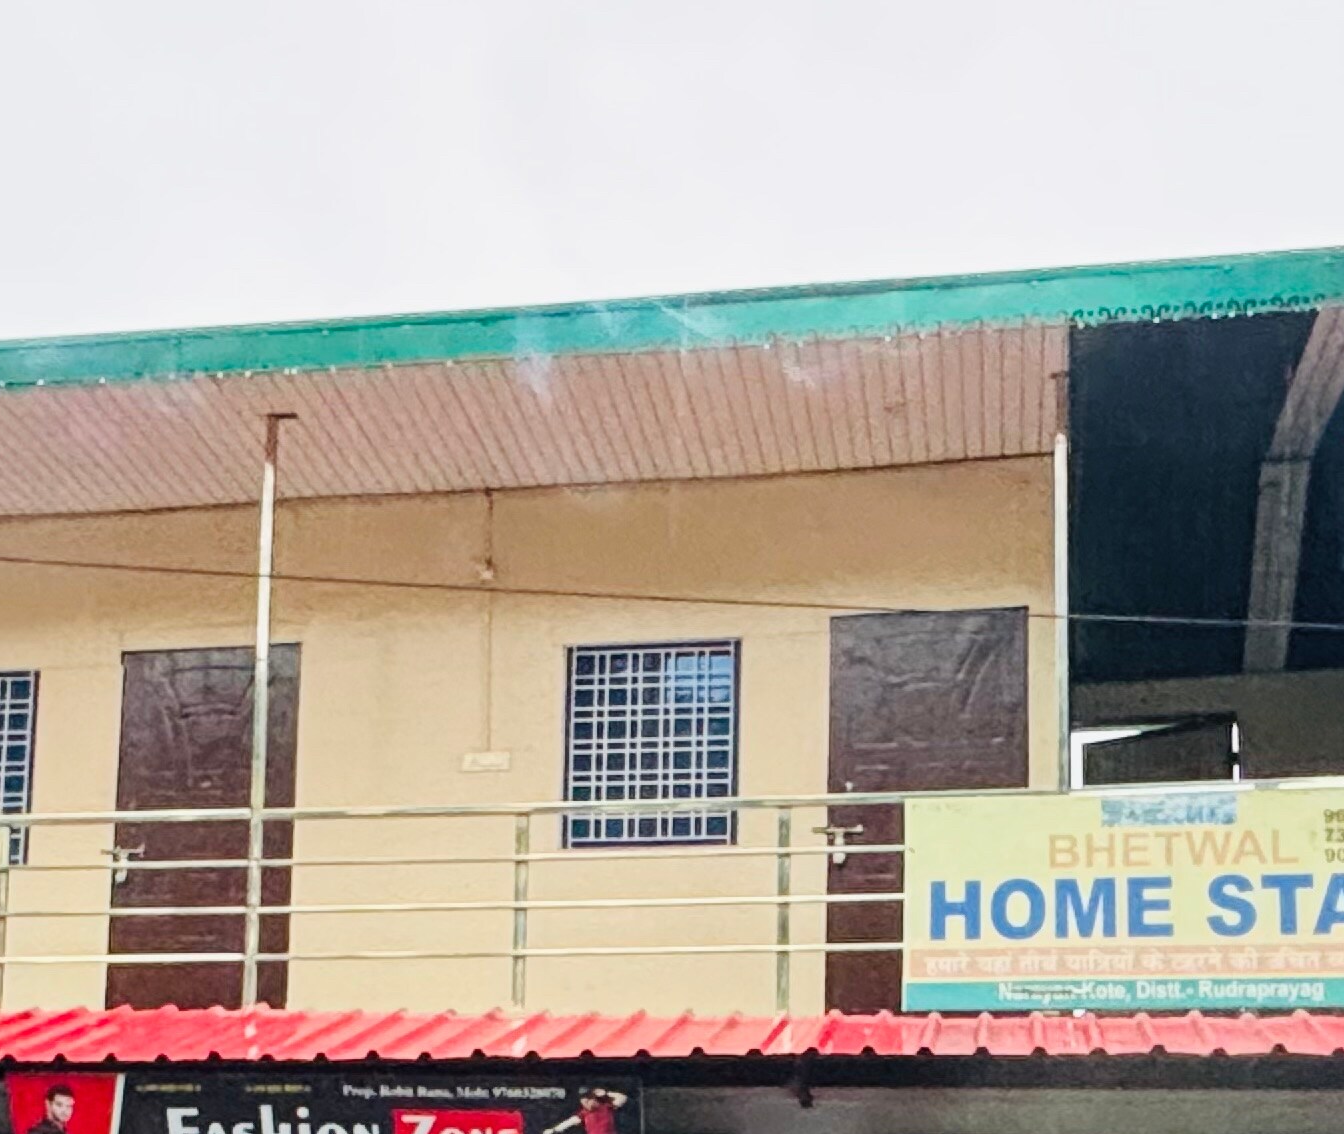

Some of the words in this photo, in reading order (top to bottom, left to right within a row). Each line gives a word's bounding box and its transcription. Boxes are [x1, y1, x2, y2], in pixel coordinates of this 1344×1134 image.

[1048, 829, 1300, 869] BHETWAL
[928, 877, 1174, 940] HOME
[1198, 979, 1325, 1001] Rudraprayag
